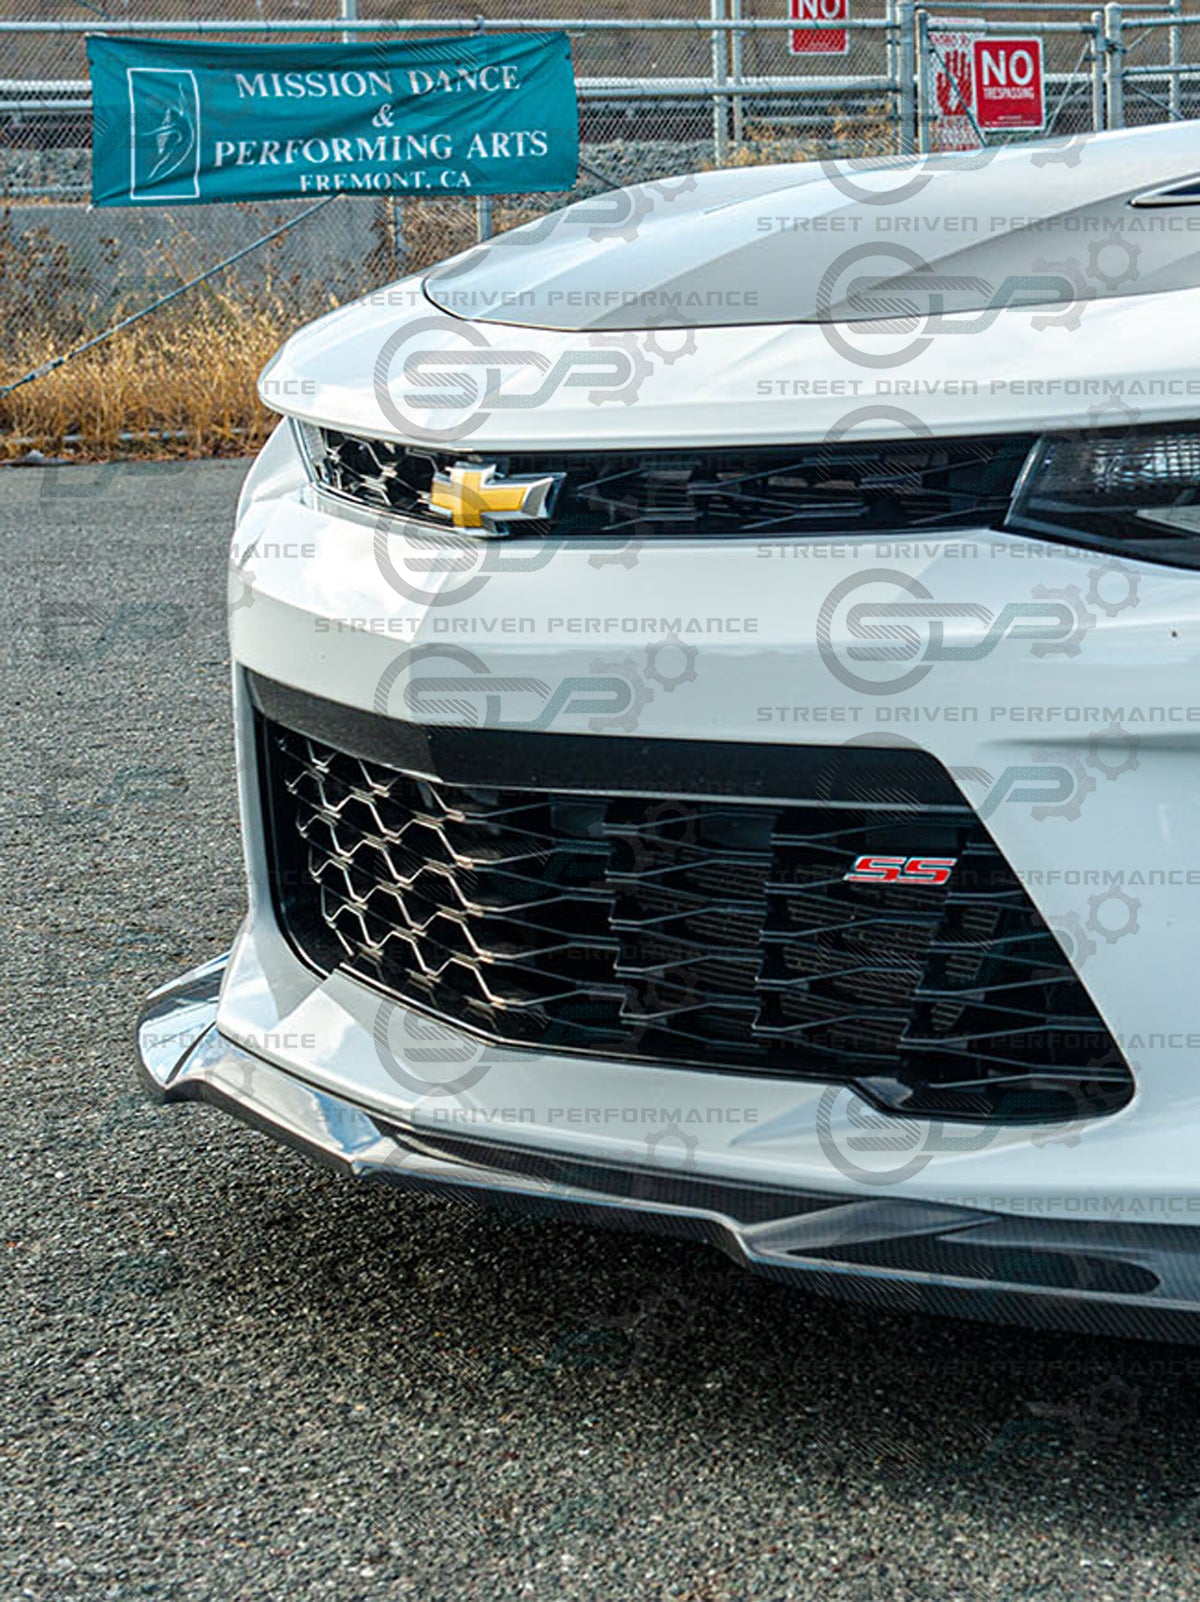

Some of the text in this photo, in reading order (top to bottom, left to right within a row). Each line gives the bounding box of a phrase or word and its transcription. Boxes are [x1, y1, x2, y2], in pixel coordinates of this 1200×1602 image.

[797, 0, 841, 18] NO
[235, 65, 521, 98] MISSION DANCE
[981, 49, 1034, 86] NO
[372, 103, 395, 128] &
[213, 130, 549, 168] PERFORMING ARTS
[440, 170, 472, 188] CA
[842, 855, 958, 885] SS
